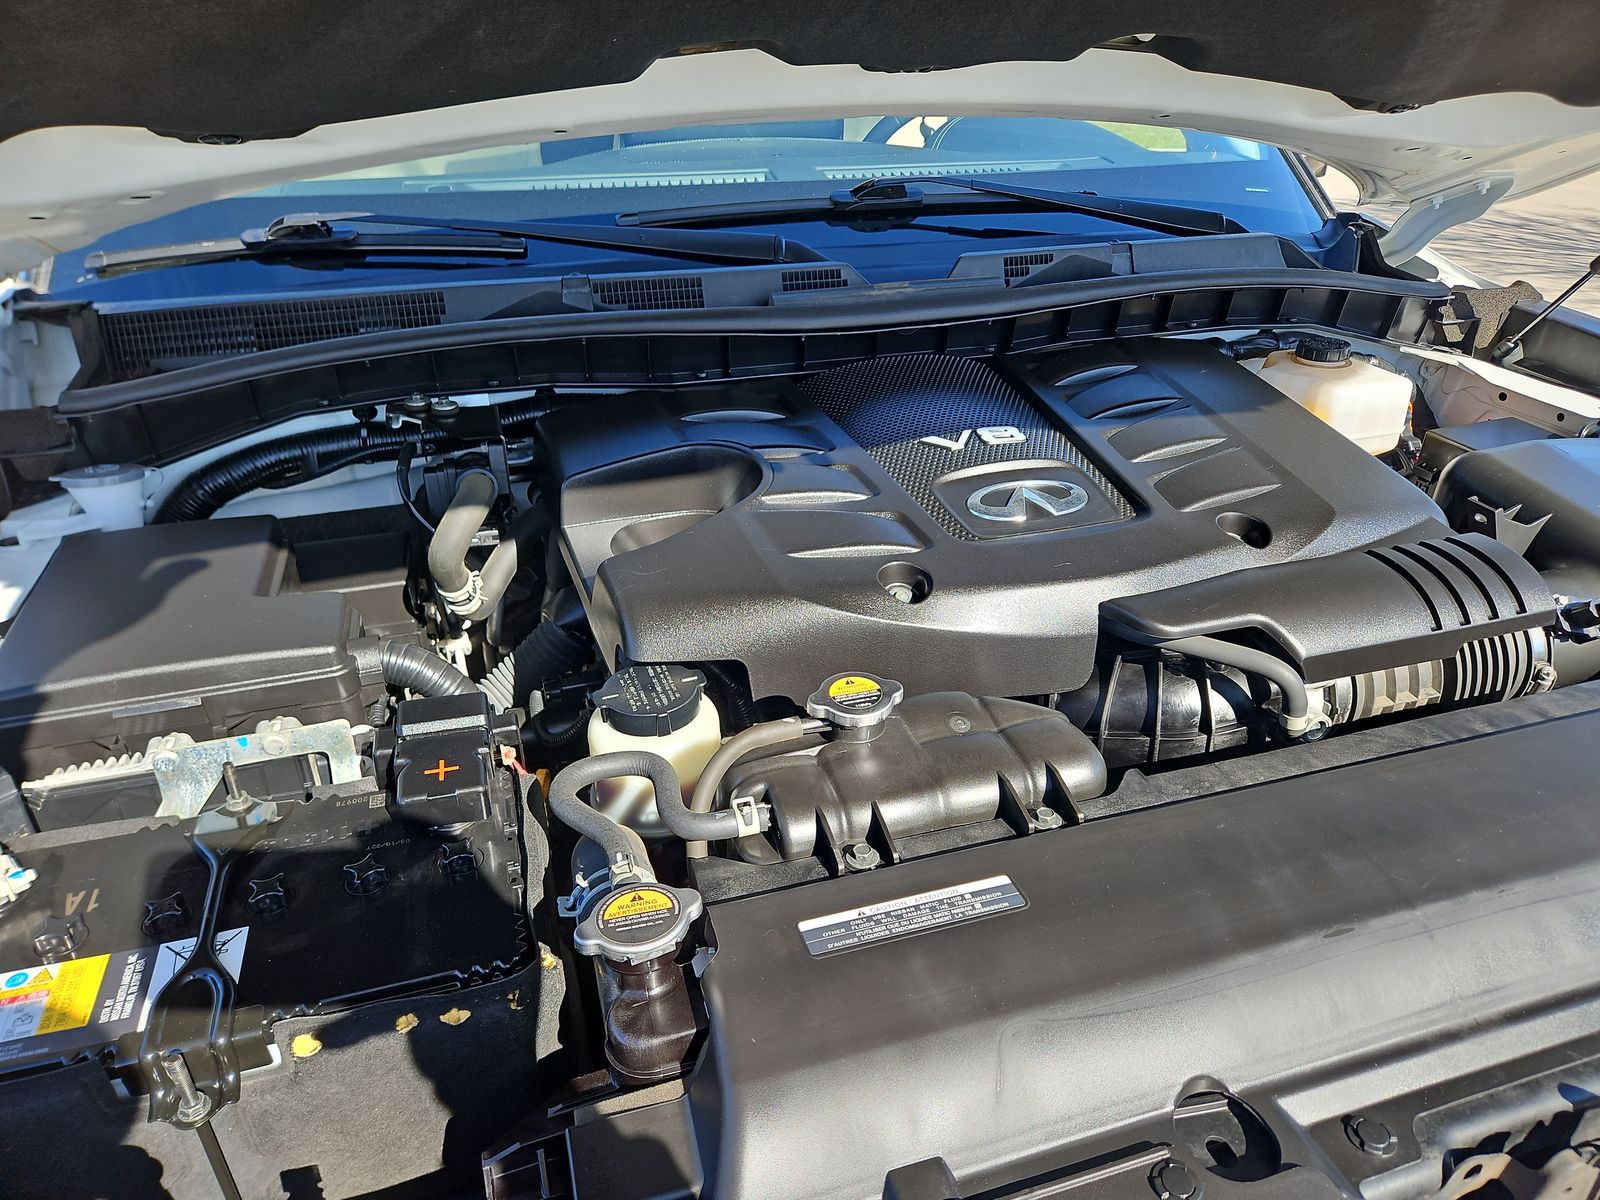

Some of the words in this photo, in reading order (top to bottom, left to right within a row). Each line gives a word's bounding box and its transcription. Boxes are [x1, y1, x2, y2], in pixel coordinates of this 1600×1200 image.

[919, 425, 1028, 451] V8
[65, 888, 99, 916] 1A
[608, 903, 669, 917] AVERTISSEMENT
[617, 899, 658, 910] WARNING
[869, 900, 907, 914] CAUTION
[914, 889, 959, 903] ATTENTION
[822, 928, 846, 938] OTHER
[851, 921, 875, 930] FLUIDS
[880, 916, 898, 924] WILL
[902, 908, 930, 918] DAMAGE
[955, 891, 1002, 906] TRANSMISSION
[850, 917, 867, 926] ONLY
[891, 906, 915, 916] NISSAN
[911, 915, 933, 925] LIQUIDE
[951, 906, 973, 914] NISSAN
[828, 938, 859, 949] D'AUTRES
[861, 930, 890, 940] LIQUIDES
[964, 902, 1009, 916] TRANSMISSION
[115, 985, 129, 1002] NORTH
[128, 985, 139, 994] TN
[110, 1001, 124, 1022] NISSAN
